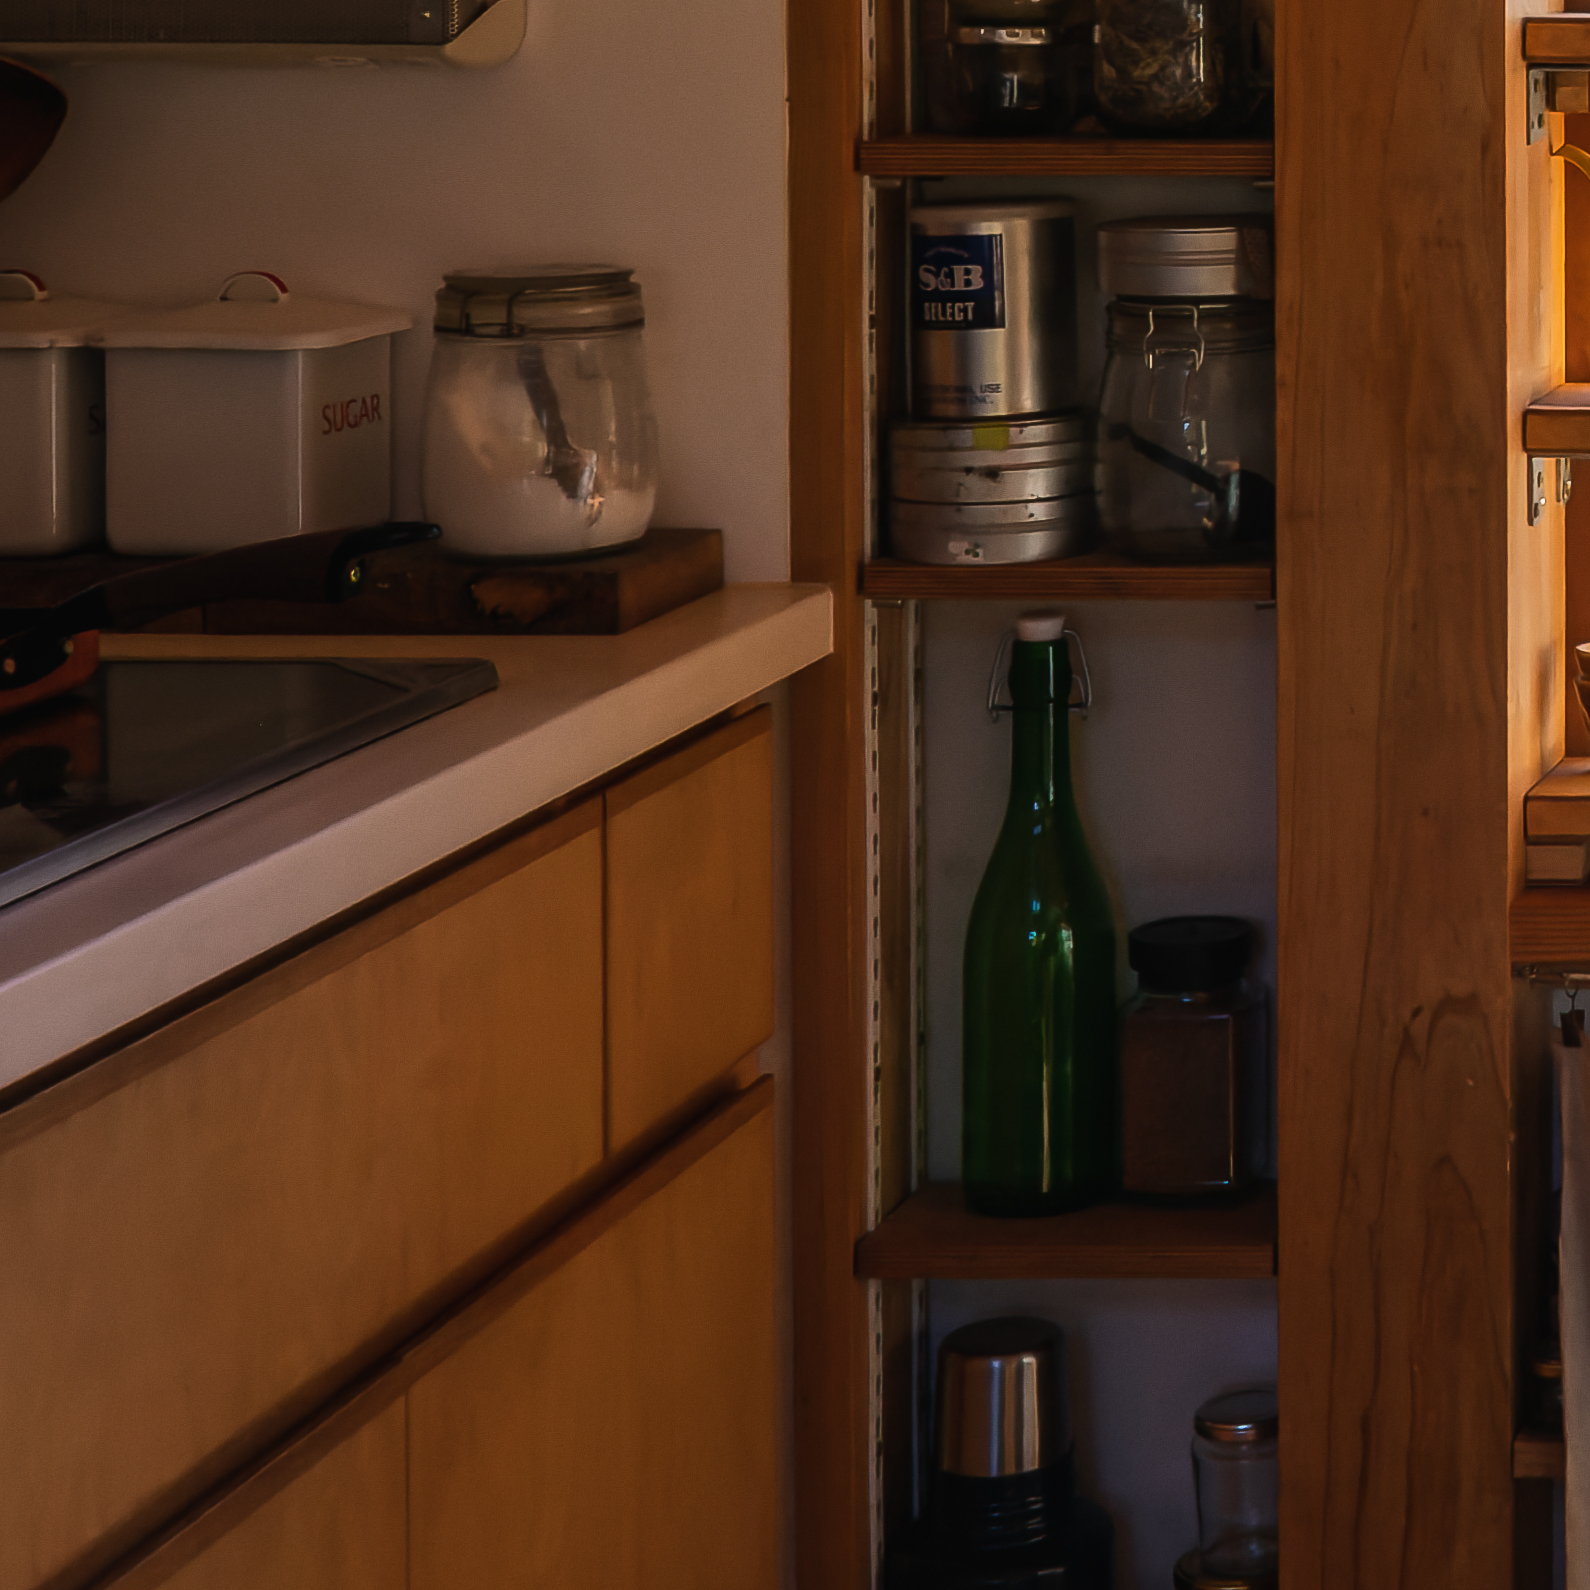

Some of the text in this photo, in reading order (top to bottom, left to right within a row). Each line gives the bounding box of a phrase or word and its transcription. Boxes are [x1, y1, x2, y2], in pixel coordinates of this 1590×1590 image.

[918, 264, 985, 292] S&B
[923, 301, 976, 321] SELECT
[88, 403, 106, 436] S
[321, 393, 382, 435] SUGAR
